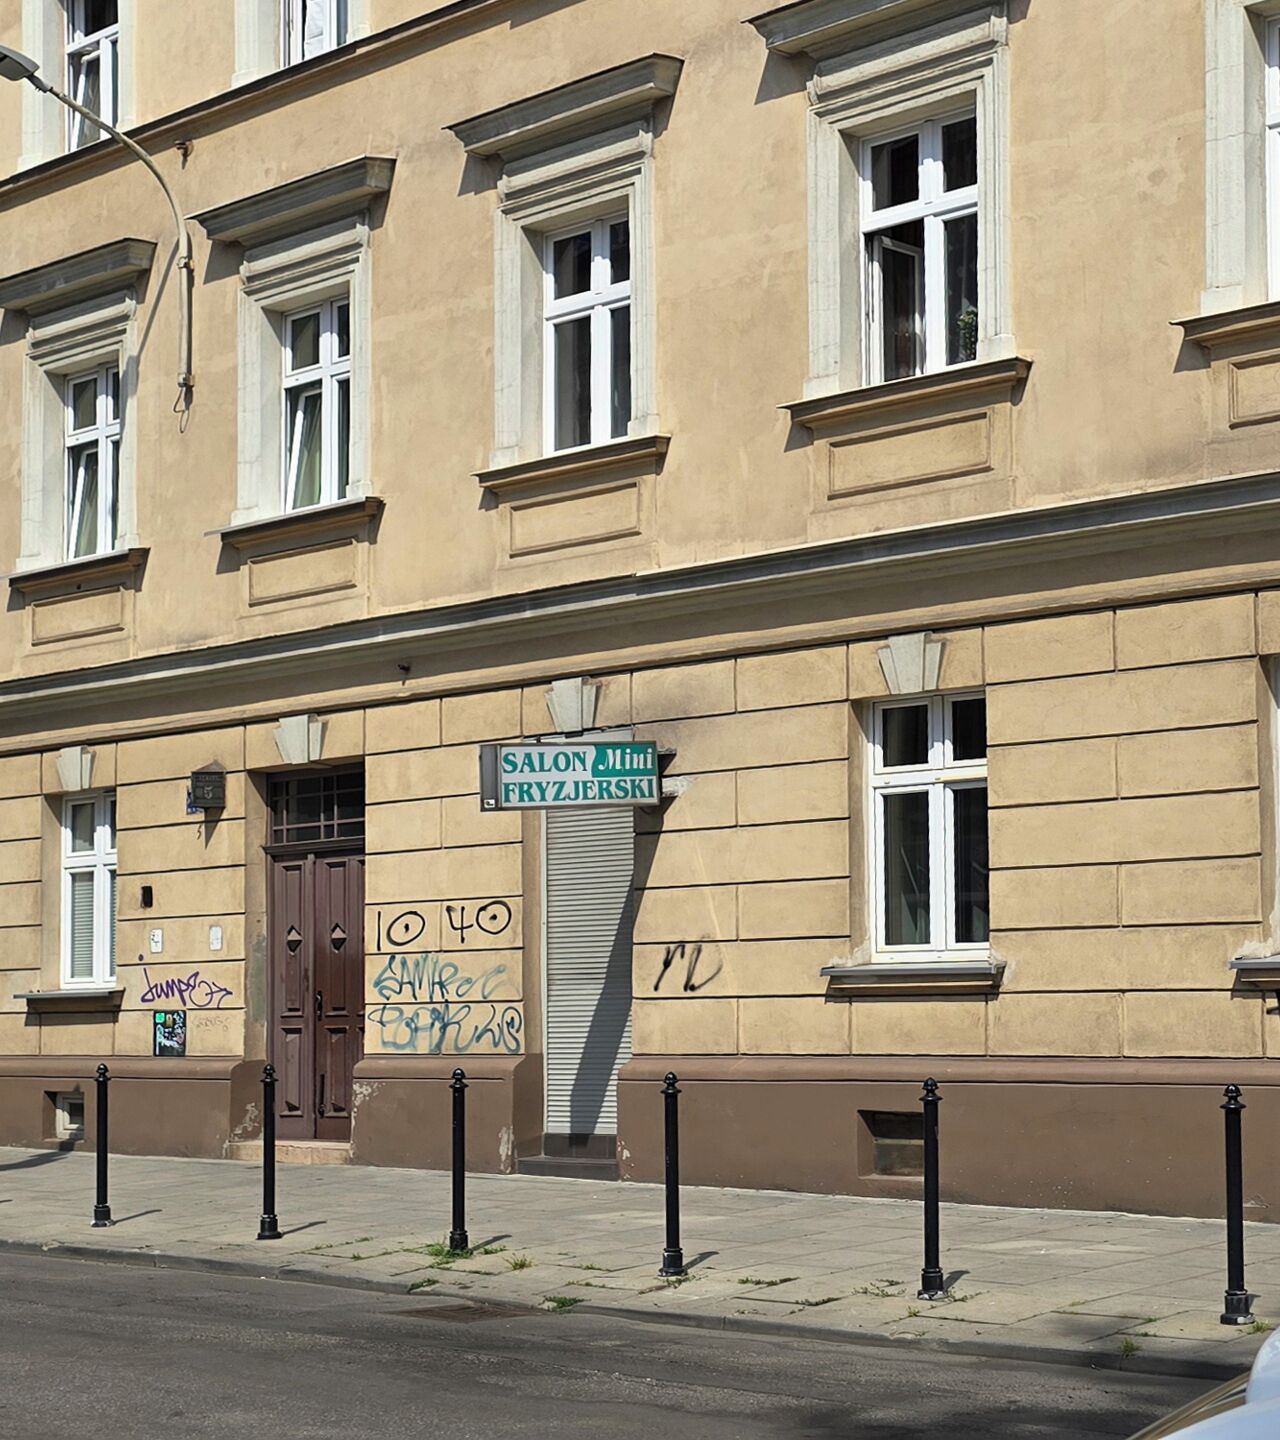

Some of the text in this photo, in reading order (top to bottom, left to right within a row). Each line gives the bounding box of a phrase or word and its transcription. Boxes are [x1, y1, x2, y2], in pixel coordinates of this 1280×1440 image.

[502, 748, 654, 774] SALON Mini
[203, 785, 213, 799] 5
[502, 778, 655, 804] FRYZJERSKI
